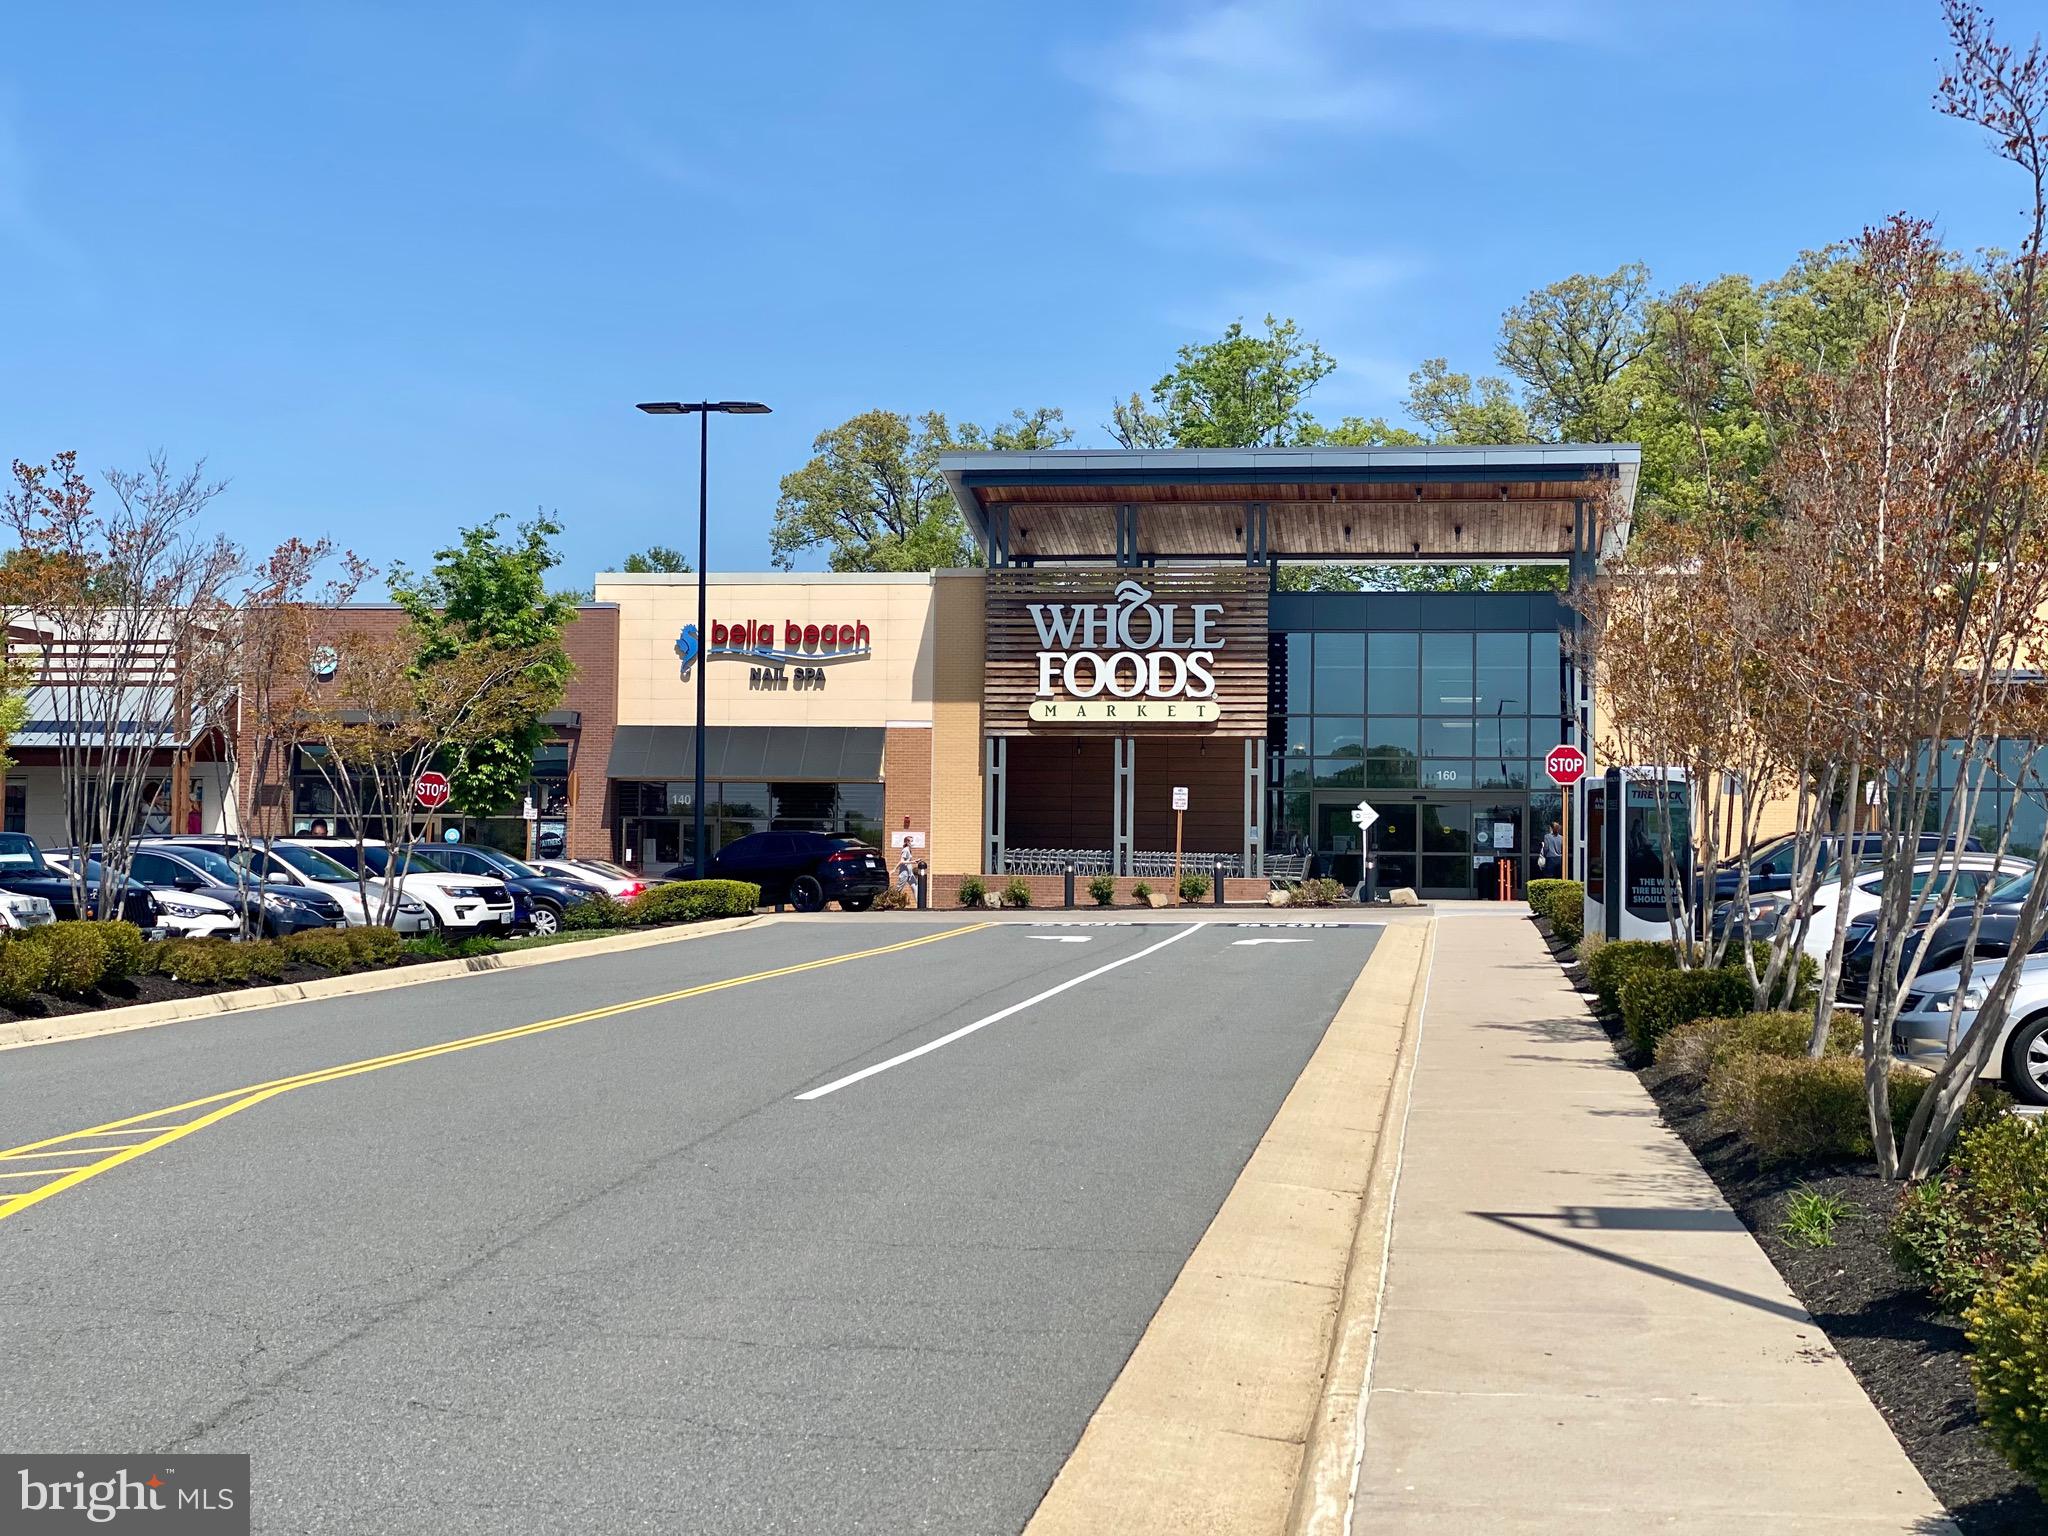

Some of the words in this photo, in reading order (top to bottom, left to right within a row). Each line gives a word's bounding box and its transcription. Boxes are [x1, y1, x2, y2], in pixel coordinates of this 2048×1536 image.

[1026, 581, 1226, 650] WHOLE
[712, 619, 774, 645] bella
[785, 619, 870, 645] beach
[750, 668, 788, 681] NAIL
[794, 668, 826, 681] SPA
[1035, 651, 1216, 698] FOODS
[1044, 704, 1206, 717] MARKET
[1549, 757, 1583, 772] STOP
[1436, 770, 1457, 781] 160
[417, 782, 447, 797] STOP
[1631, 790, 1654, 800] TIRE
[672, 794, 691, 805] 140
[1639, 878, 1656, 886] THE
[1656, 878, 1676, 886] WY
[1631, 886, 1650, 895] TIRE
[1632, 895, 1667, 904] SHOULD
